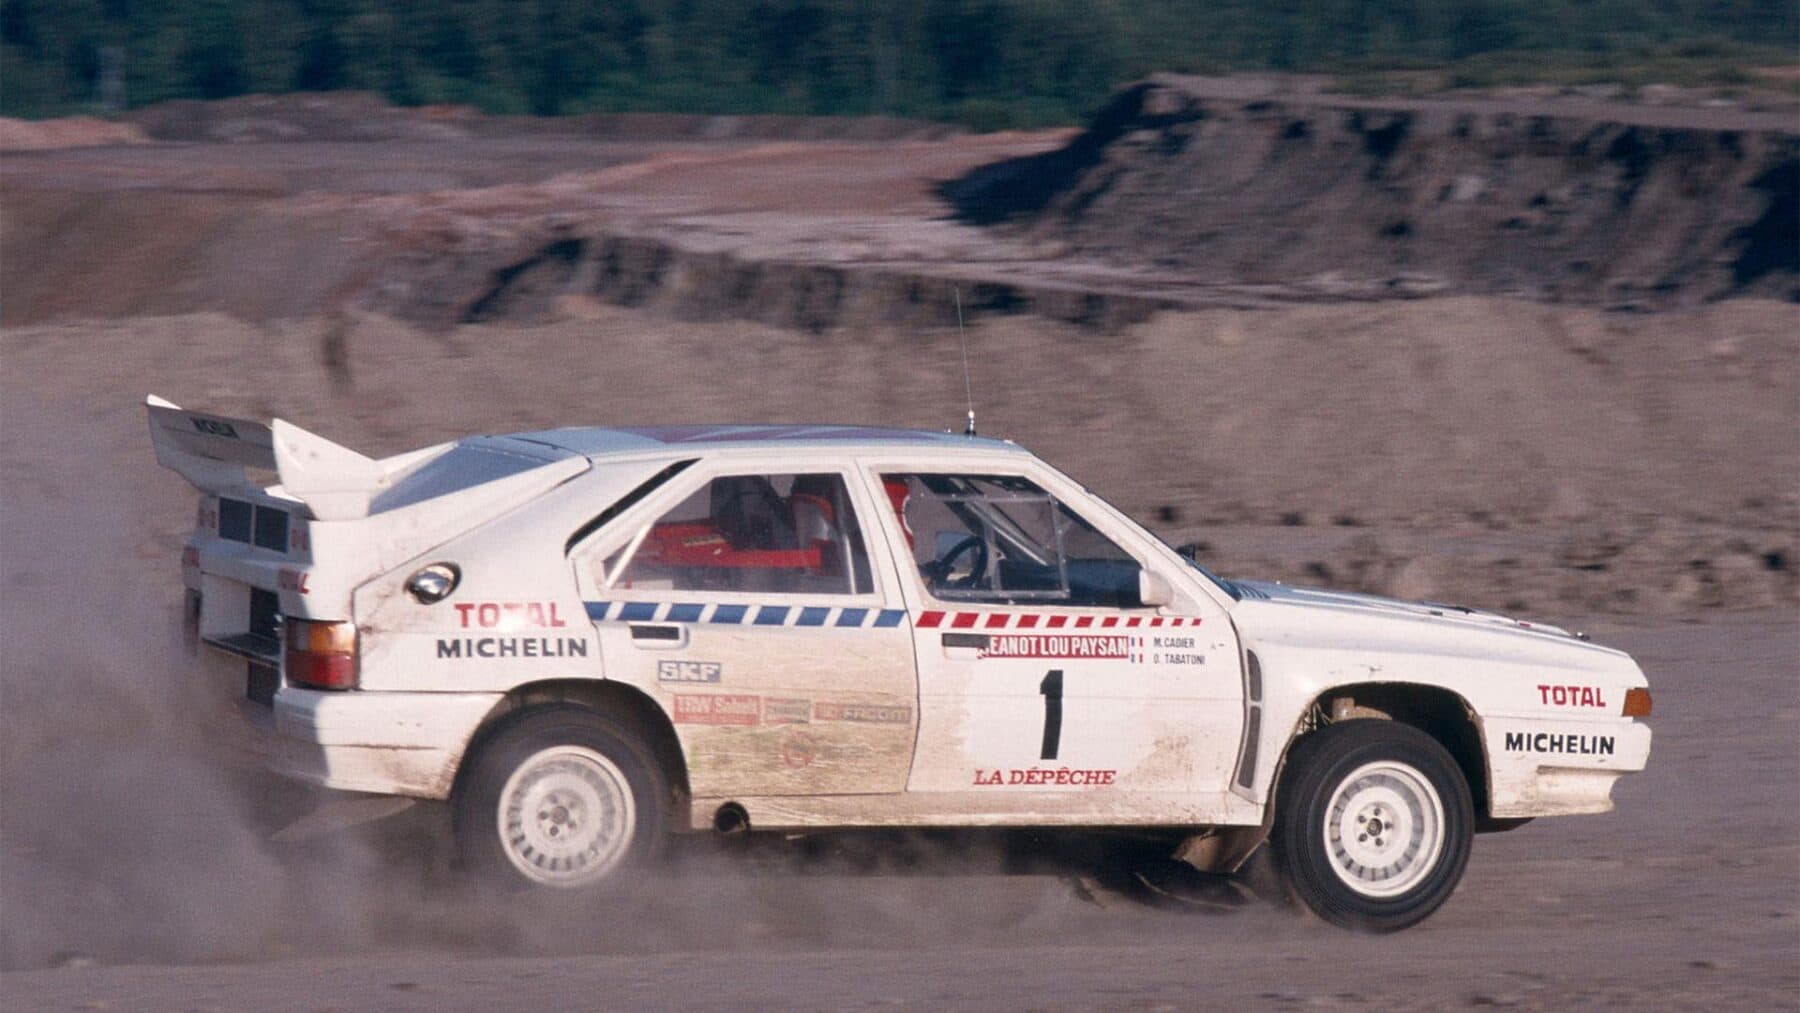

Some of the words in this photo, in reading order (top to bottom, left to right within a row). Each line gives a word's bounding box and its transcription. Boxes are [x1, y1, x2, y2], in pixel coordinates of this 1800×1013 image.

[437, 637, 587, 659] MICHELIN
[1040, 636, 1070, 656] LOU
[1071, 636, 1128, 656] PAYSAN
[660, 661, 720, 682] SKF
[1537, 684, 1607, 708] TOTAL
[1040, 669, 1064, 760] 1
[1505, 732, 1616, 755] MICHELIN
[973, 769, 1004, 786] LA
[1008, 766, 1118, 786] DÉPÊCHE
